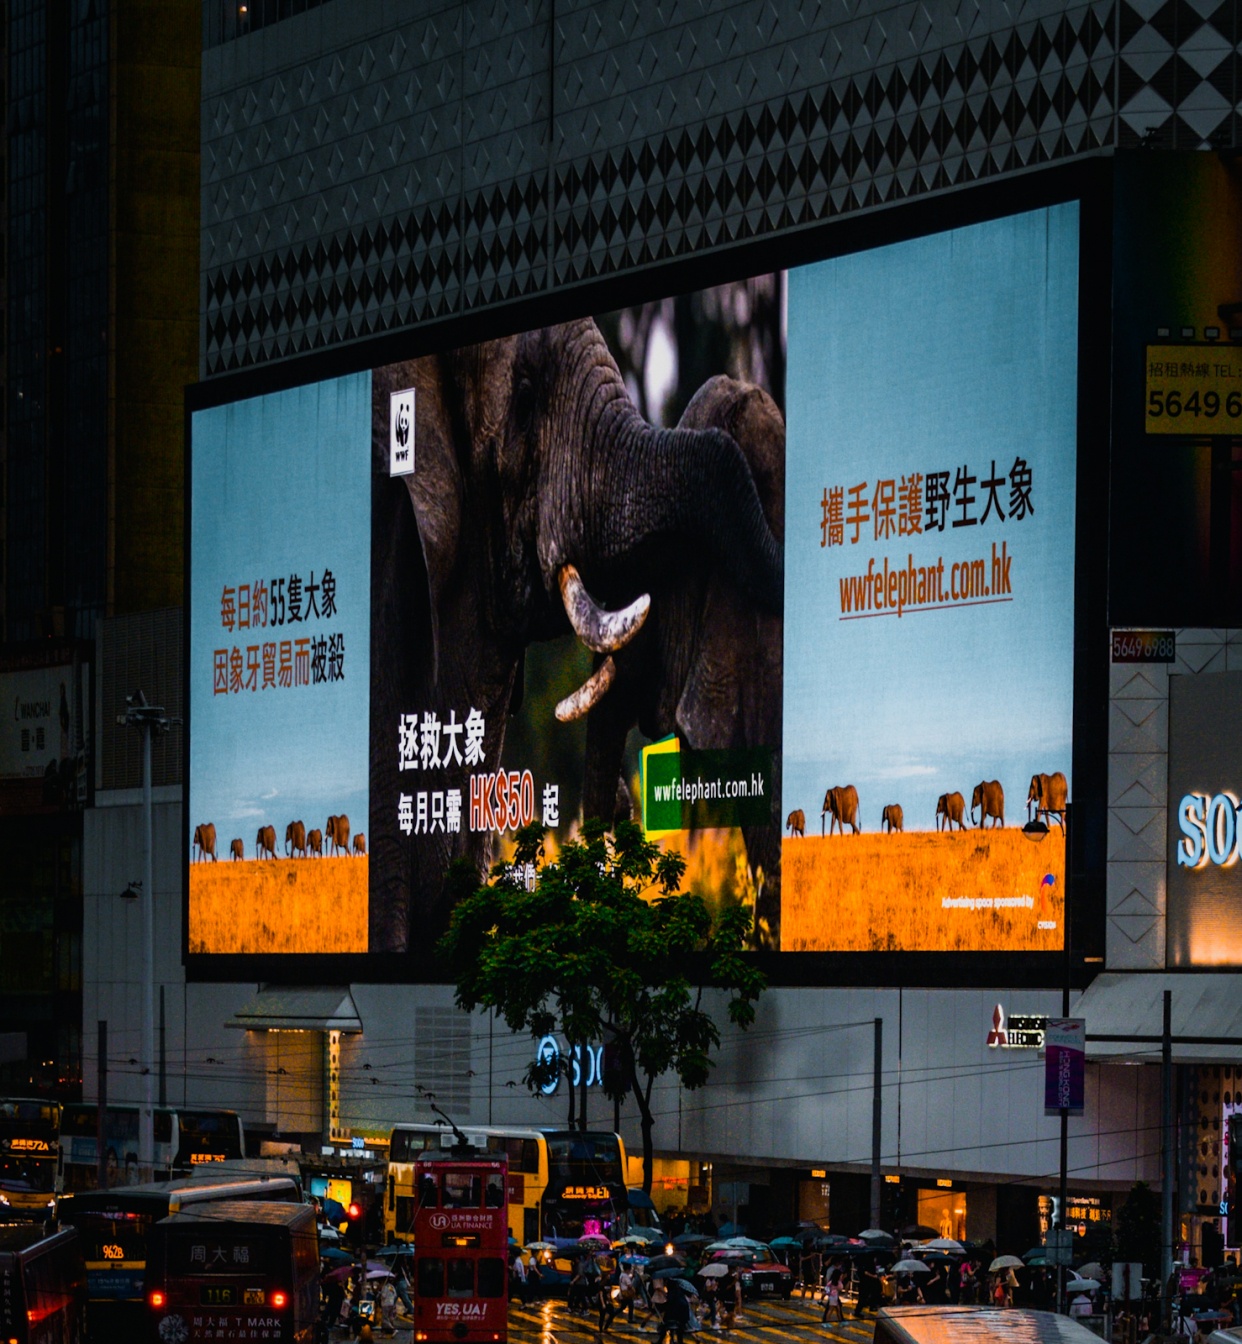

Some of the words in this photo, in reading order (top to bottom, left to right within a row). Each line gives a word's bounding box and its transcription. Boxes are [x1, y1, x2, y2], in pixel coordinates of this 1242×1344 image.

[1149, 362, 1210, 378] 招租熱線
[1148, 390, 1220, 418] 5649
[820, 456, 1035, 548] 攜手保護野生大象
[839, 540, 1012, 618] wwfelephant.com.hk
[220, 568, 337, 633] 每日約55隻大象
[1113, 636, 1143, 658] 5649
[1143, 636, 1174, 658] 6988
[213, 633, 345, 697] 因象牙貿易而被殺
[398, 706, 487, 772] 拯救大象
[397, 788, 463, 836] 每月只需
[469, 766, 535, 836] HK$50
[541, 782, 560, 828] 起
[653, 771, 765, 805] wwfelephant.com.hk
[1176, 792, 1242, 869] SO
[33, 1140, 49, 1151] 72A
[463, 1222, 493, 1230] FINANCE
[190, 1245, 250, 1264] 周大福
[207, 1288, 231, 1303] 116
[193, 1316, 228, 1327] 周大福
[235, 1317, 243, 1327] T
[247, 1317, 282, 1327] MARK
